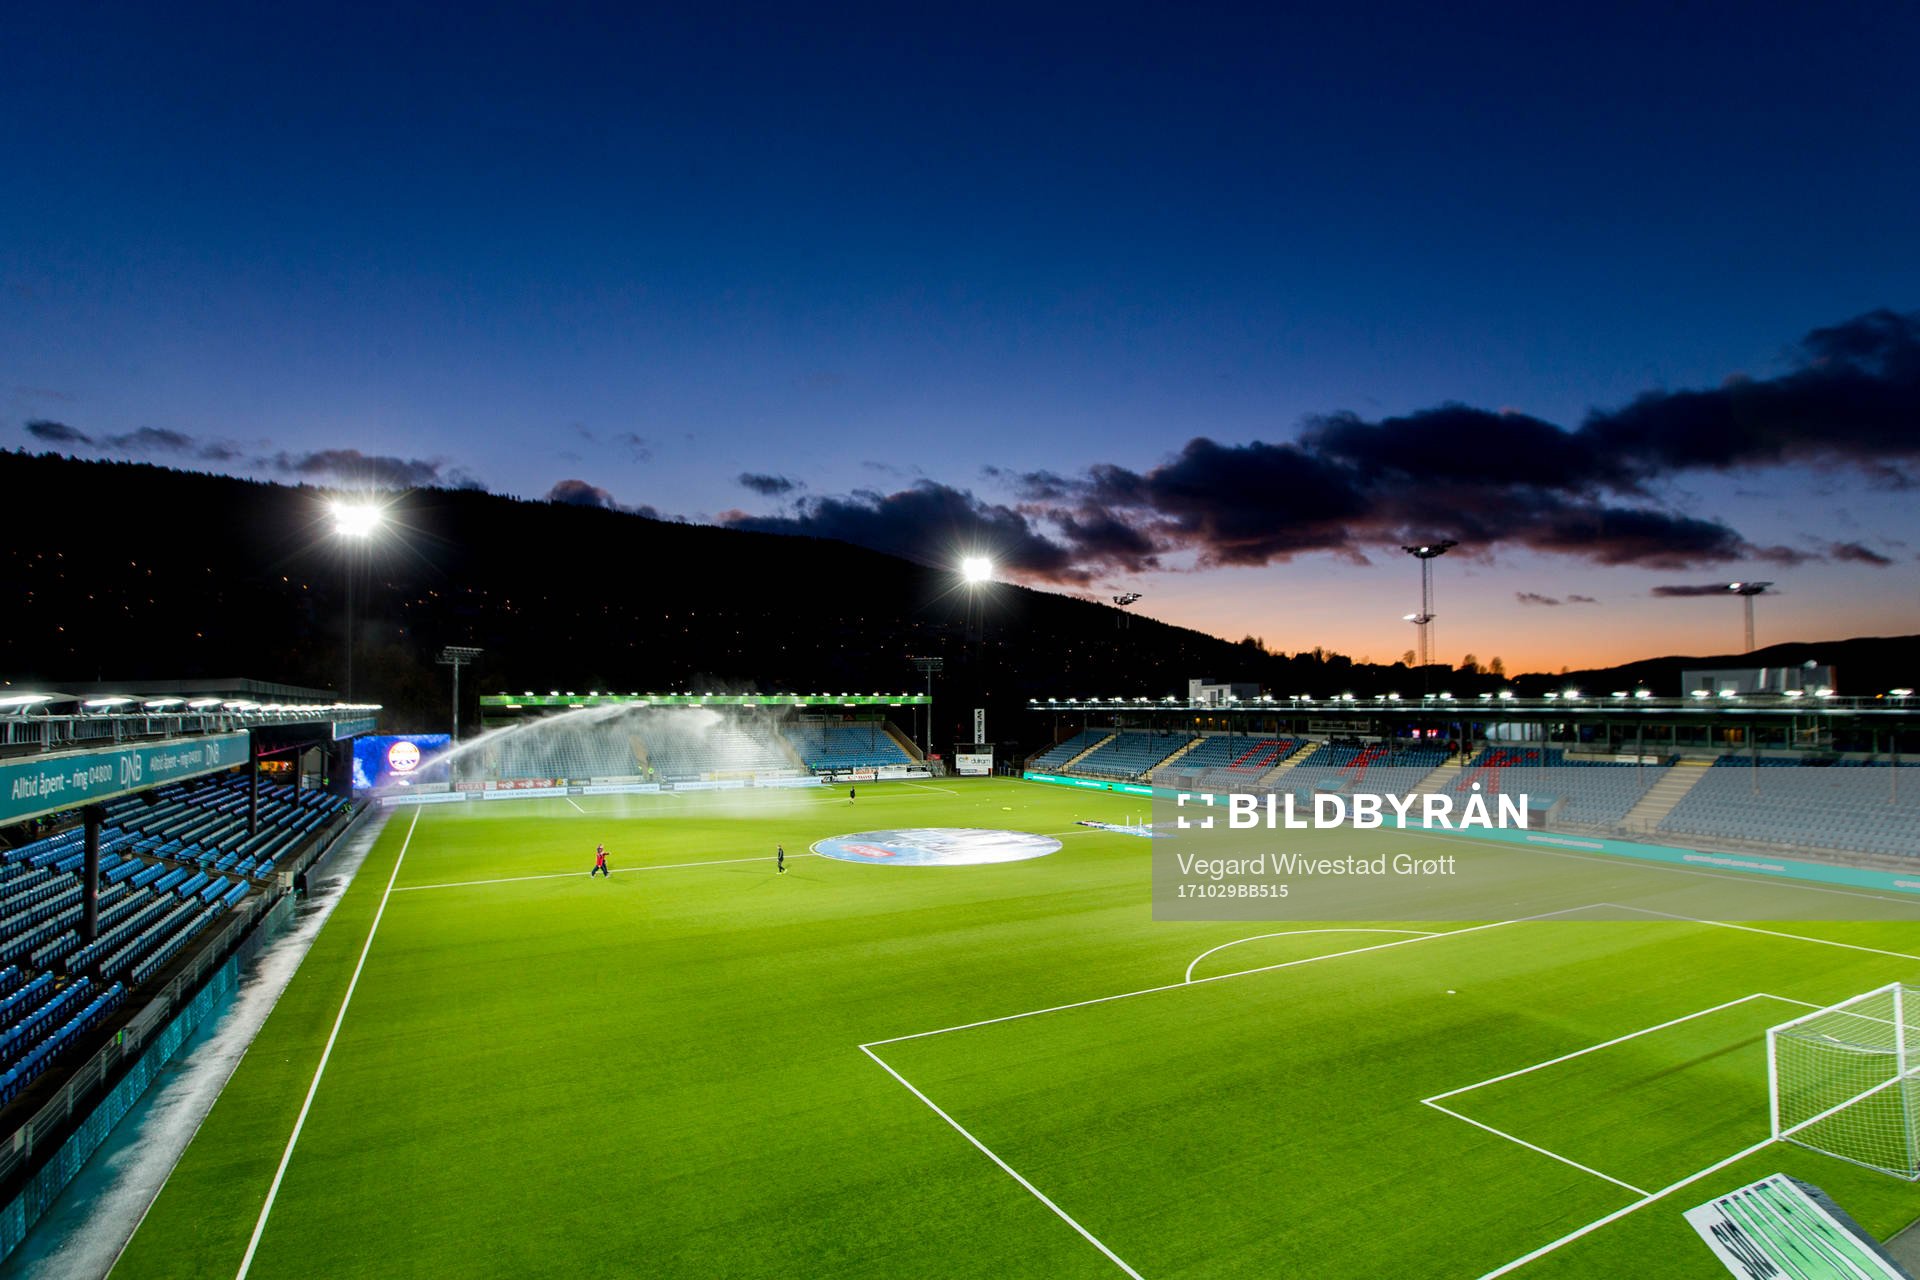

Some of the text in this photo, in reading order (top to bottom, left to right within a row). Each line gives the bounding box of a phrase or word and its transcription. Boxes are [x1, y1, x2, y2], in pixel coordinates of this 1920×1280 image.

[12, 775, 38, 800] Alltid
[39, 773, 65, 799] åpent
[72, 769, 88, 791] ring
[88, 764, 113, 785] 04800
[120, 752, 142, 789] DNB
